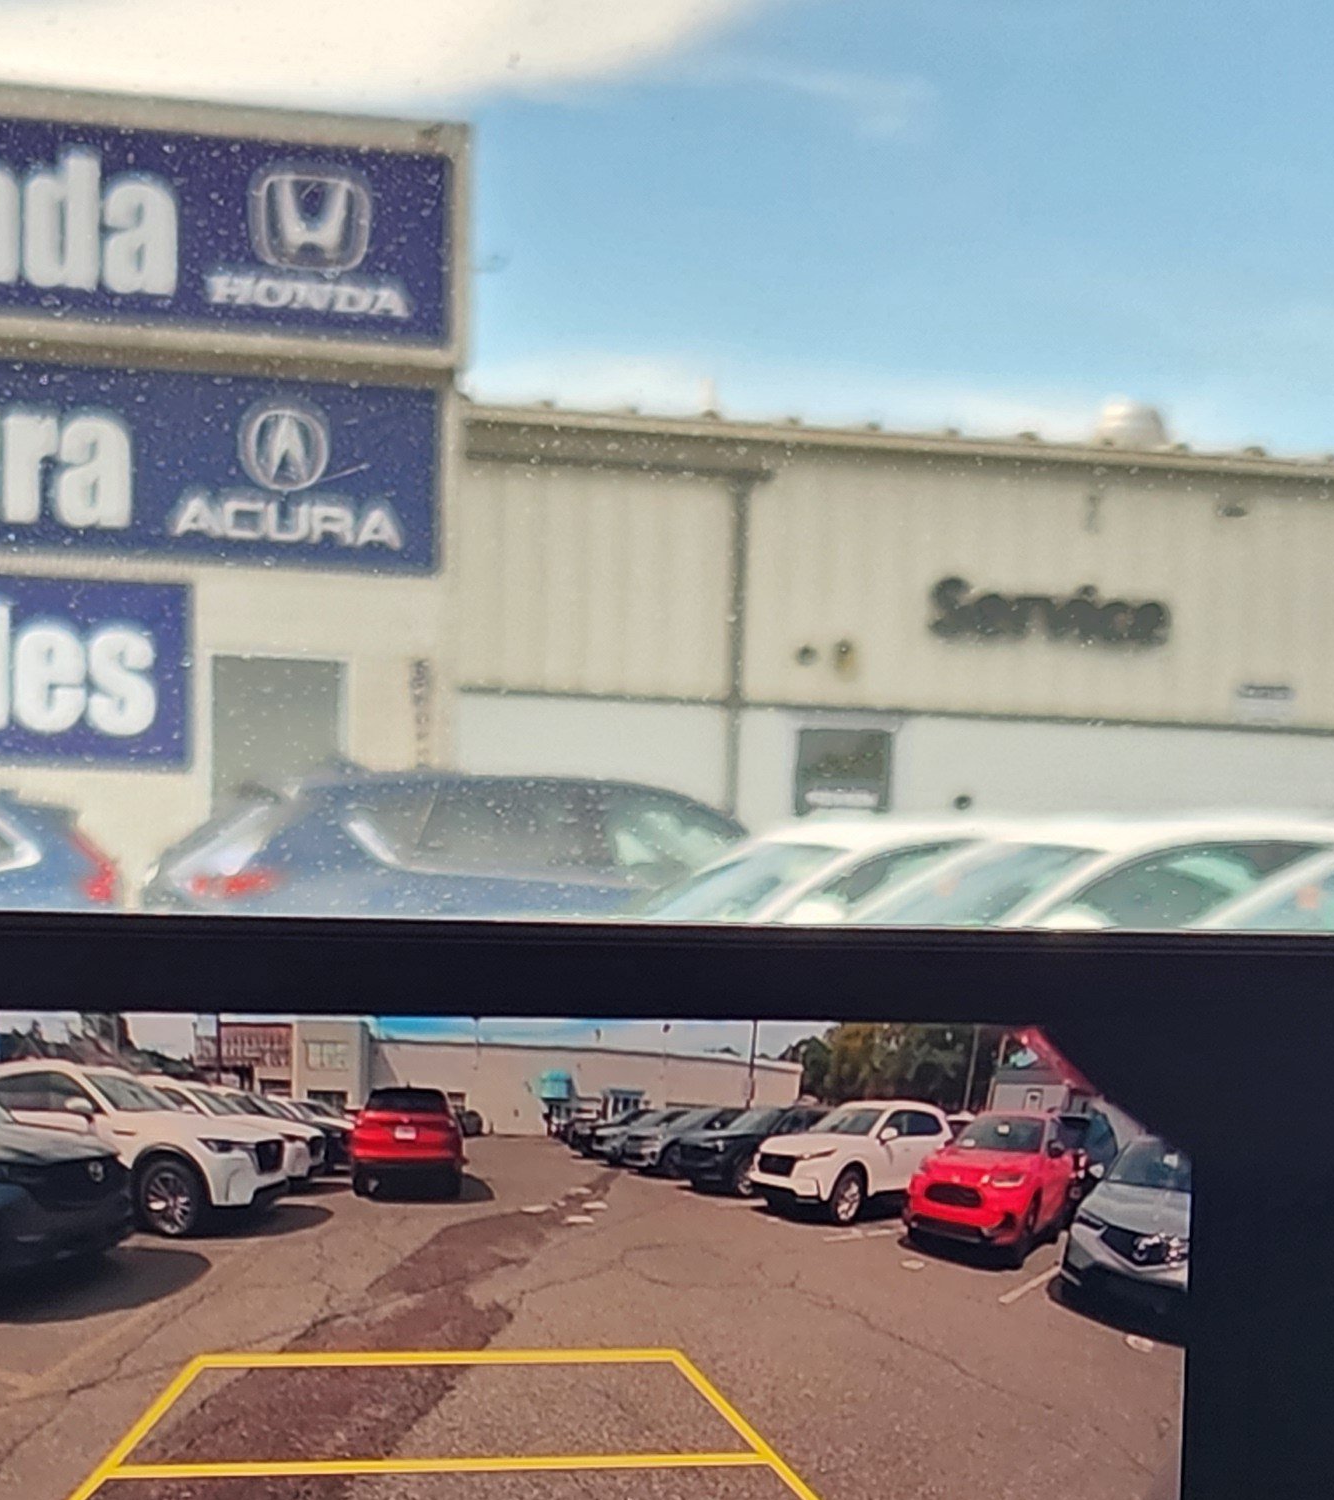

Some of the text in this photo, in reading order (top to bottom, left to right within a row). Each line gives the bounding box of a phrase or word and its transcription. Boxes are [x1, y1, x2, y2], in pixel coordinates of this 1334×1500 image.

[205, 274, 410, 318] HONDA
[171, 494, 403, 551] ACURA
[929, 575, 1171, 648] Service
